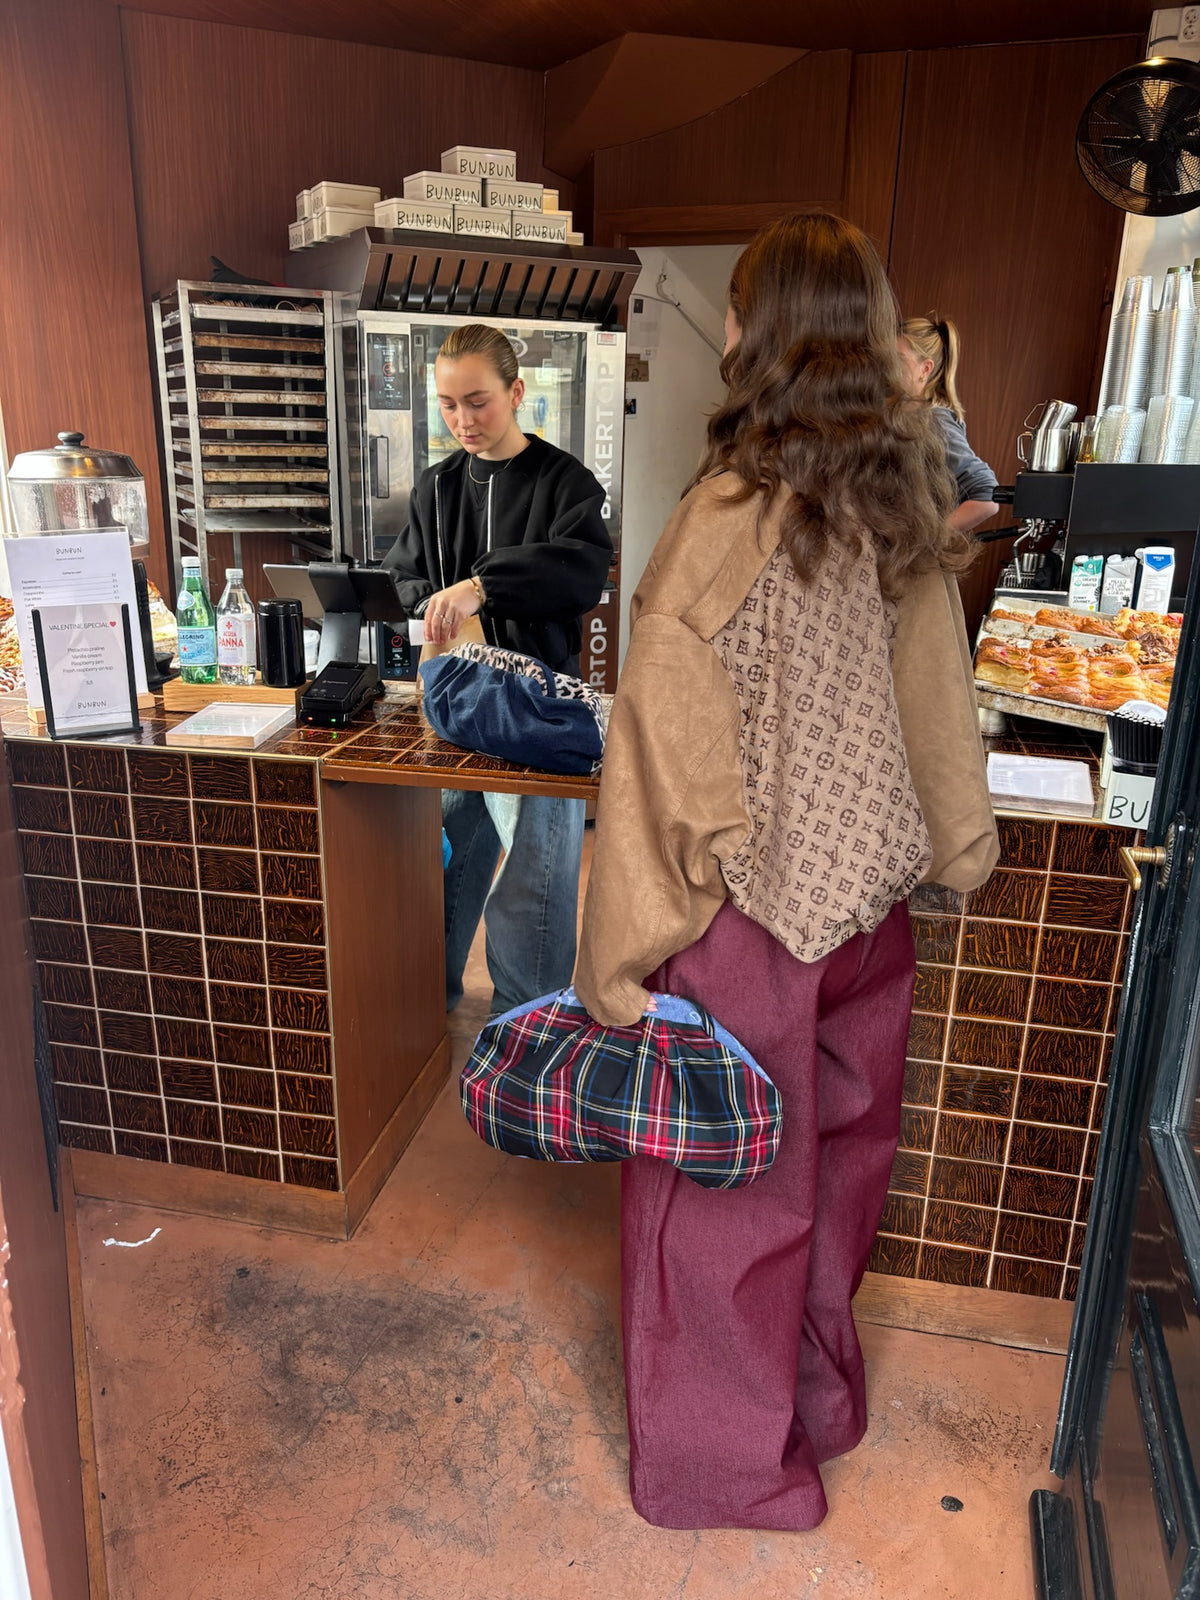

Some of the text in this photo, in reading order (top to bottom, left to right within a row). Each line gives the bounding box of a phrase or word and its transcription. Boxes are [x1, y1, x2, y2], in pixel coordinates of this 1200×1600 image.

[459, 158, 515, 178] BUNBUN
[426, 184, 481, 204] BUNBUN
[490, 191, 542, 210] BUNBUN
[397, 211, 452, 230] BUNBUN
[456, 217, 510, 236] BUNBUN
[514, 223, 566, 241] BUNBUN
[55, 546, 82, 555] BUNBUN
[589, 617, 607, 693] RTOP
[78, 701, 107, 709] BUNBUN
[1109, 796, 1149, 823] BU
